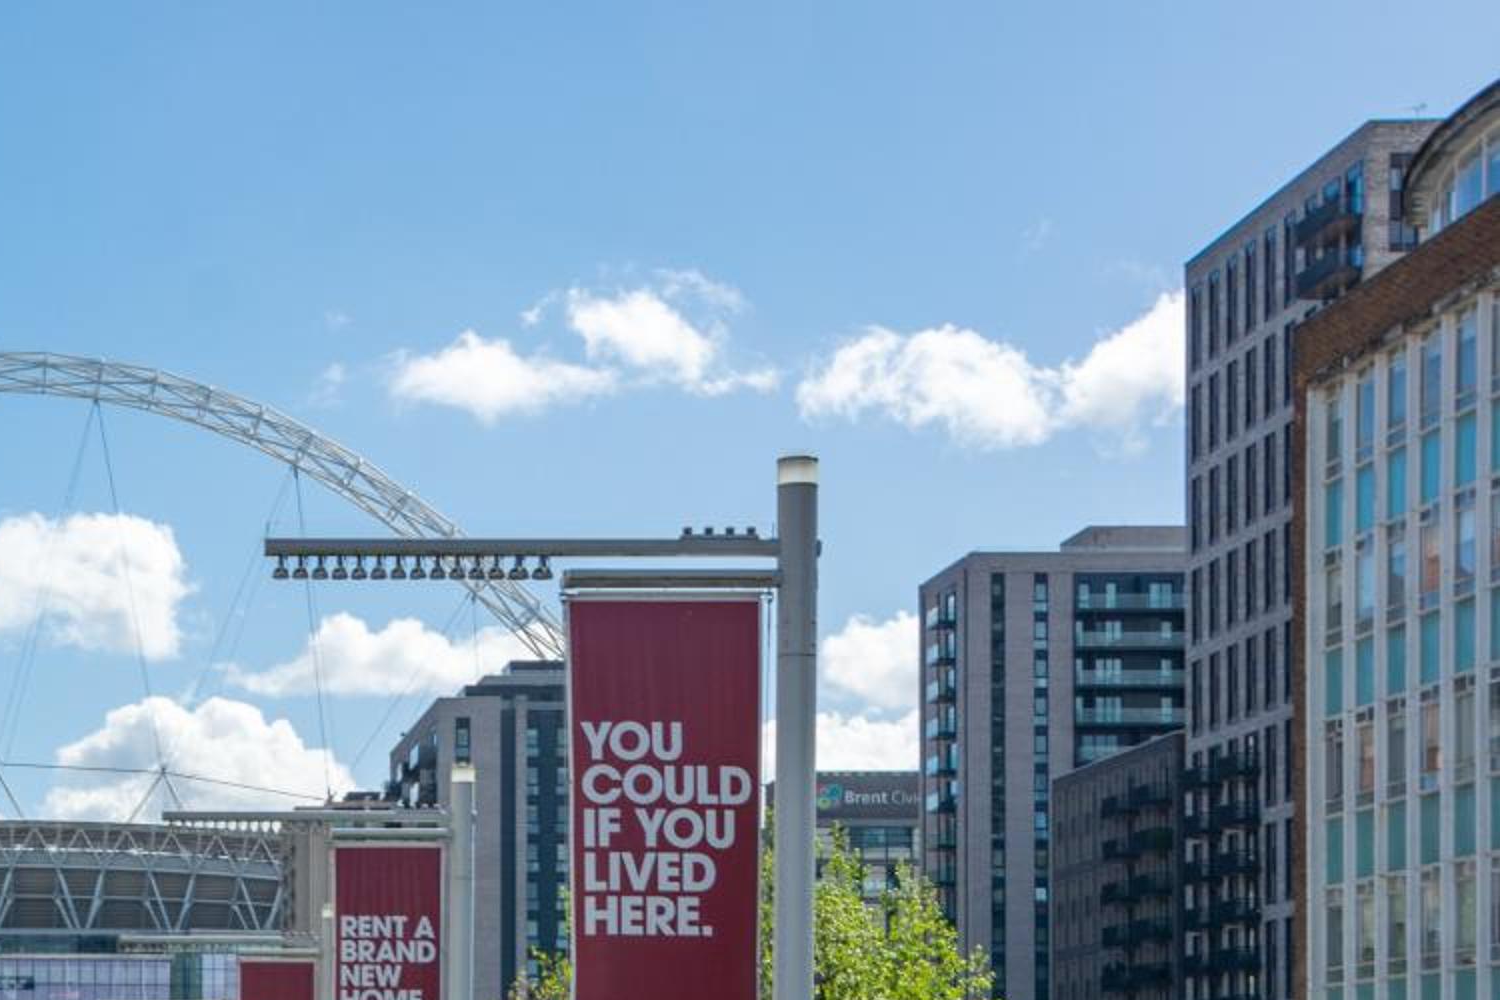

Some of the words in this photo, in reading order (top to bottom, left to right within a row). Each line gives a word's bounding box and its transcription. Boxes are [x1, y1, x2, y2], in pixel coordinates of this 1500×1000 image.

[580, 721, 683, 760] YOU
[581, 764, 751, 805] COULD
[844, 790, 888, 804] Brent
[584, 808, 622, 848] IF
[635, 808, 735, 849] YOU
[584, 851, 716, 892] LIVED
[340, 916, 408, 938] RENT
[414, 916, 436, 938] A
[584, 896, 713, 936] HERE.
[340, 940, 436, 962] BRAND
[340, 964, 402, 987] NEW
